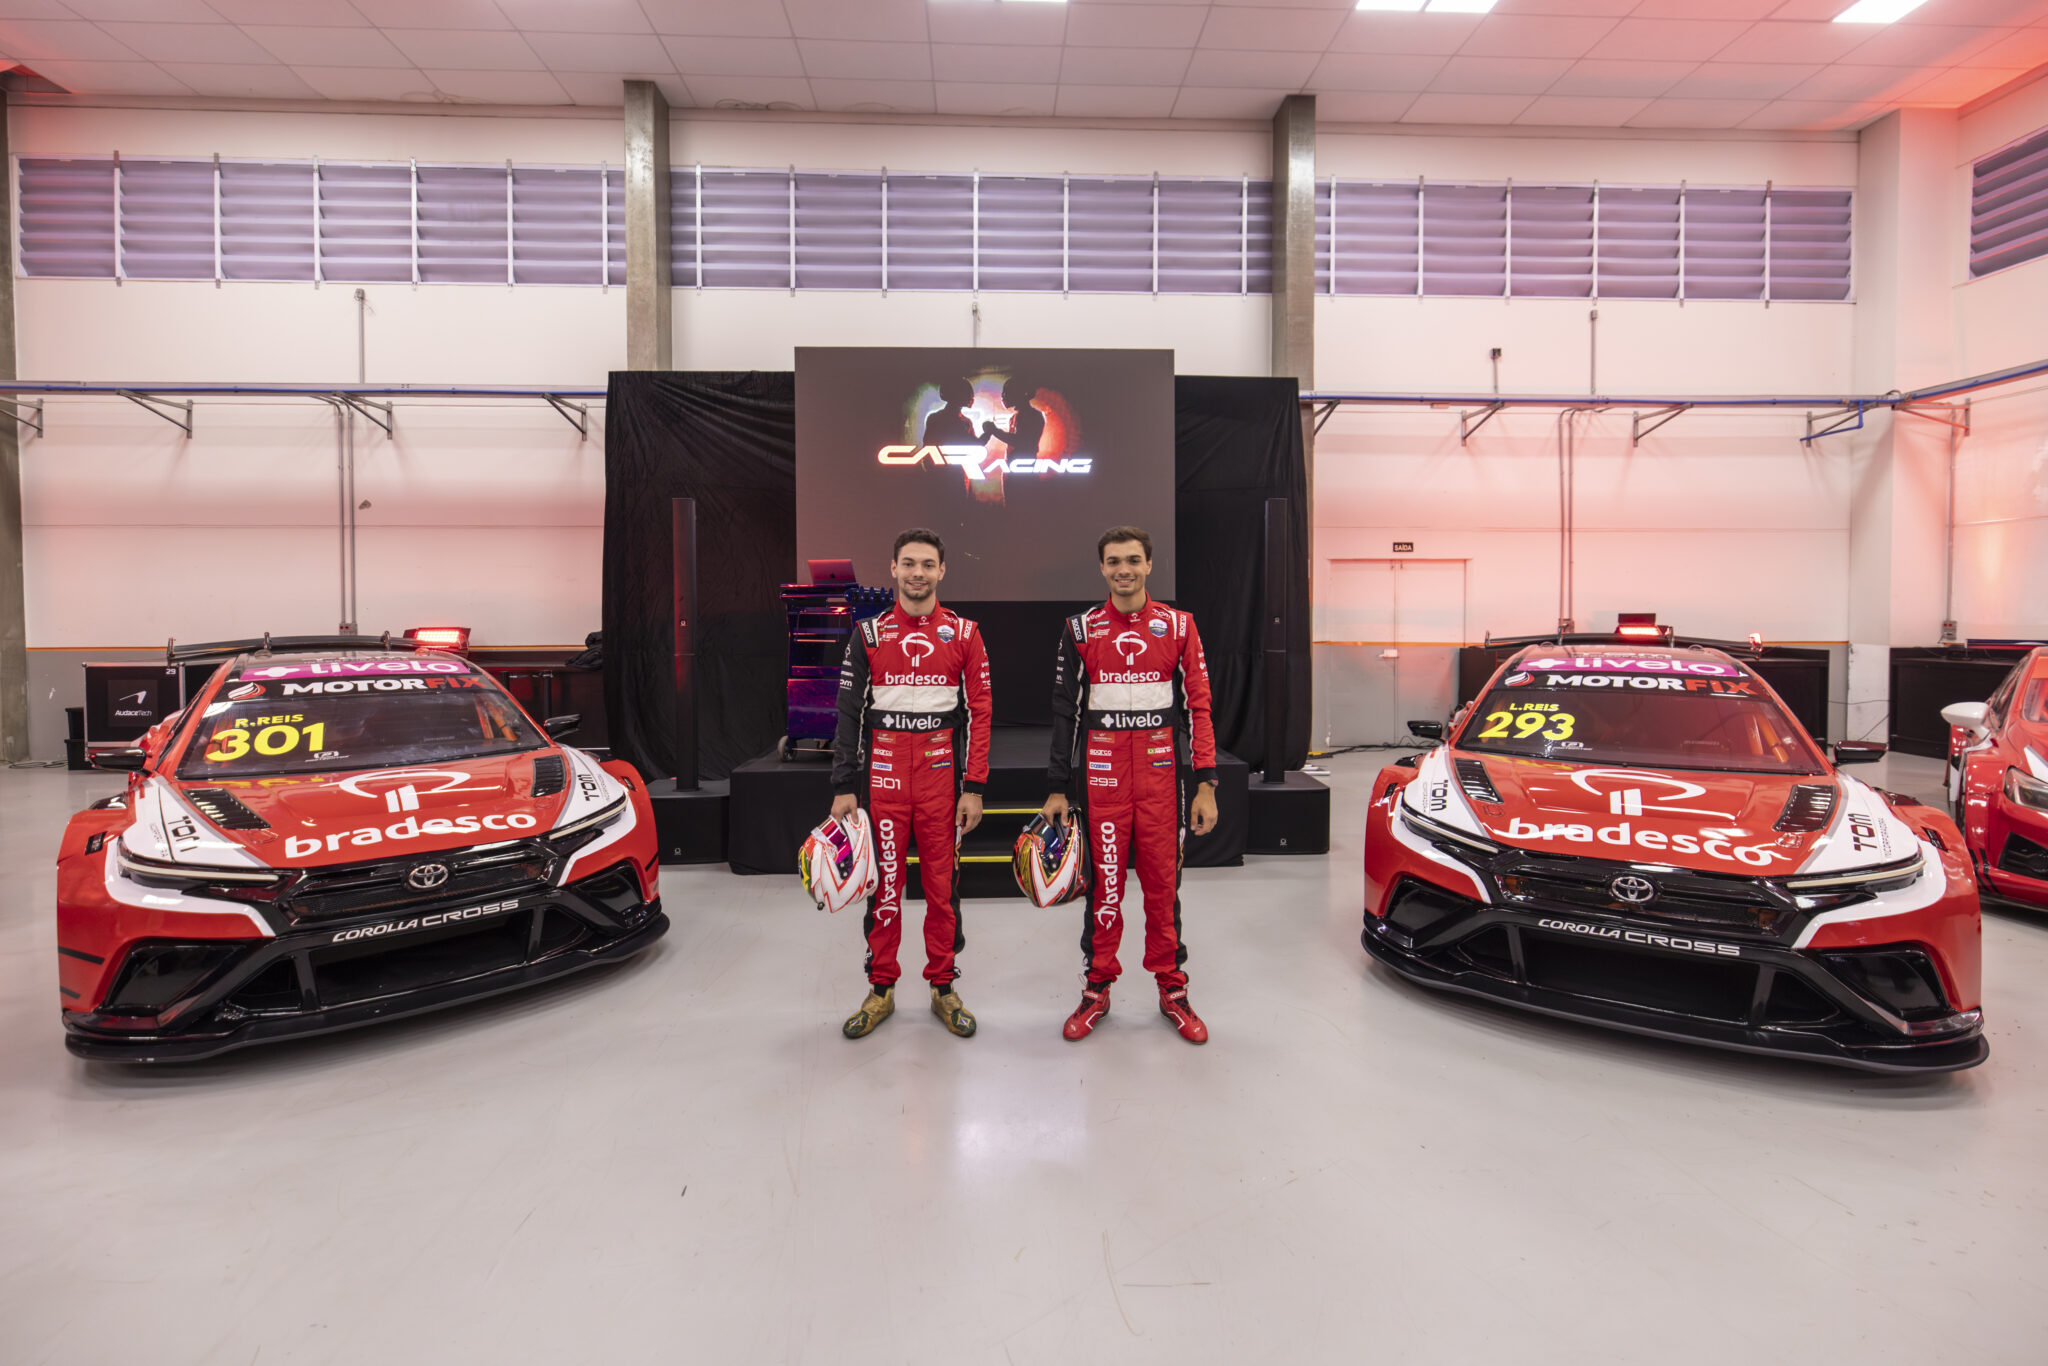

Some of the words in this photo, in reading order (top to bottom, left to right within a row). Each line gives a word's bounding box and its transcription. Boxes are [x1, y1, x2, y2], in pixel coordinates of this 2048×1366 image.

[311, 660, 459, 675] livelo
[1575, 657, 1725, 675] livelo
[885, 672, 947, 685] bradesco
[1100, 670, 1161, 683] bradesco
[1546, 674, 1758, 695] MOTORFIX
[282, 676, 488, 696] MOTORFIX
[115, 709, 152, 717] AudaceTech
[1510, 702, 1560, 711] L.REIS
[235, 714, 304, 728] R.REIS
[895, 714, 942, 730] livelo
[1115, 712, 1162, 728] livelo
[1478, 711, 1576, 740] 293
[206, 722, 325, 762] 301
[872, 776, 900, 790] 301
[1089, 777, 1118, 787] 293
[285, 813, 537, 859] bradesco
[1507, 817, 1774, 866] bradesco
[879, 818, 898, 900] bradesco
[1099, 821, 1119, 904] bradesco
[332, 918, 418, 943] COROLLA
[421, 900, 519, 927] CROSS
[1538, 918, 1621, 940] COROLLA
[1623, 931, 1740, 956] CROSS
